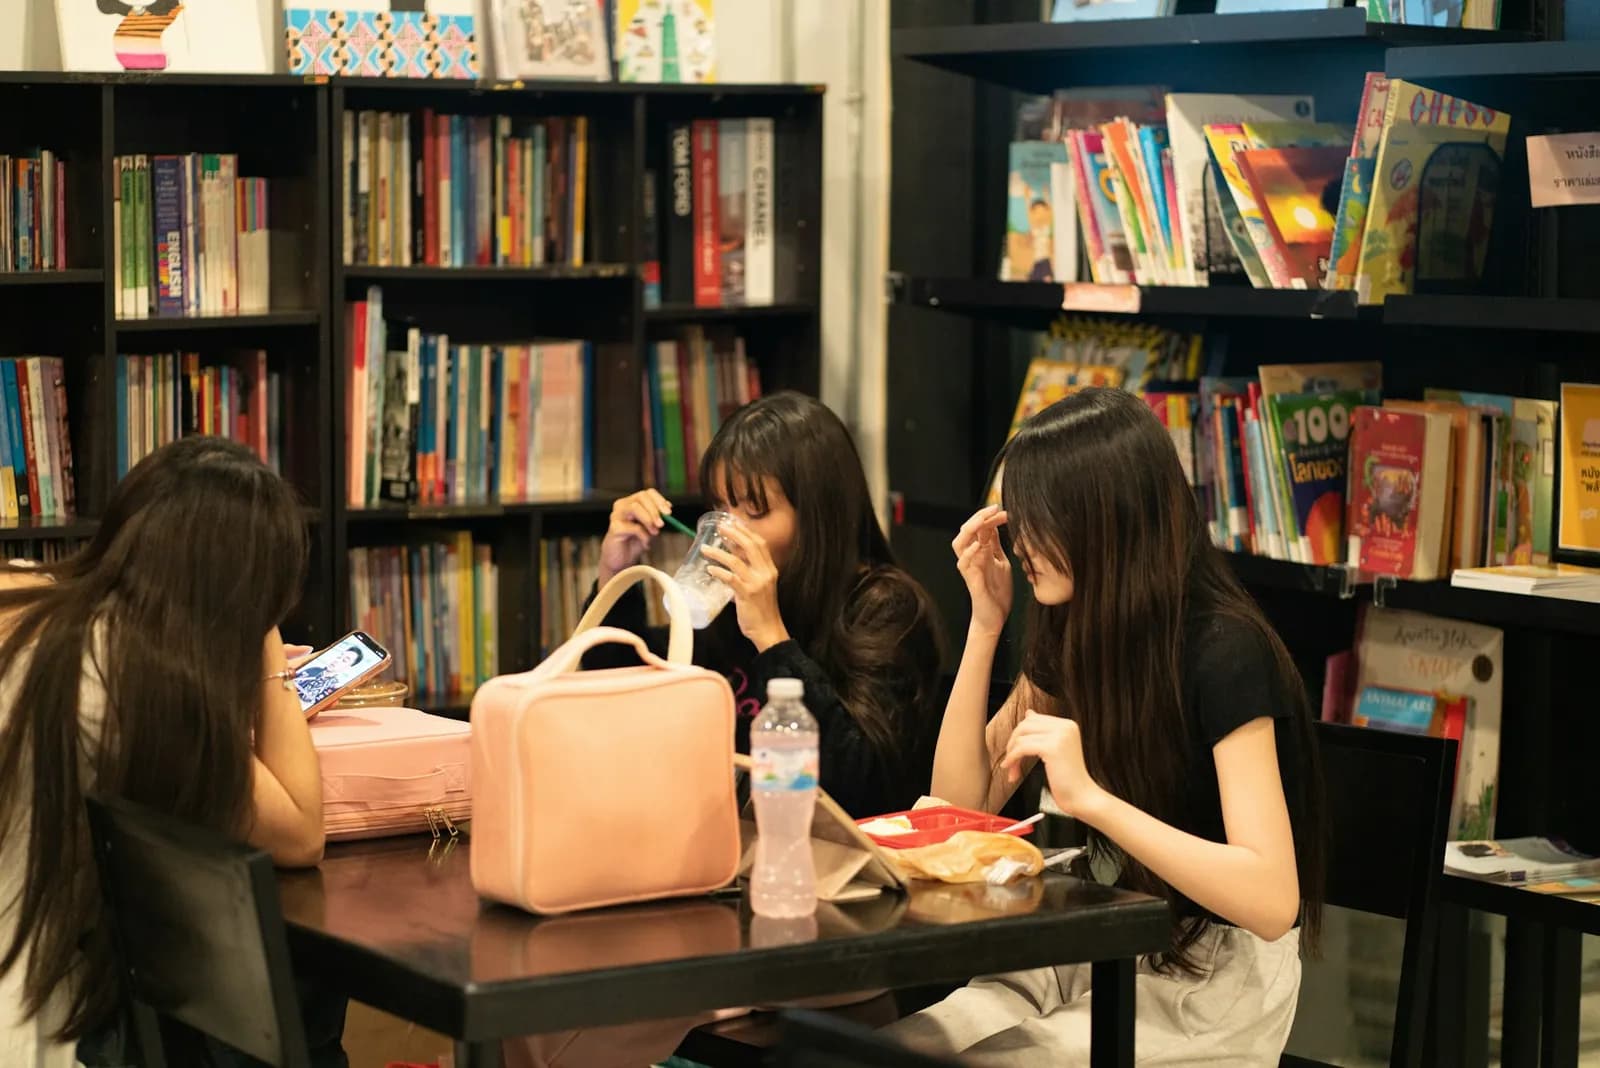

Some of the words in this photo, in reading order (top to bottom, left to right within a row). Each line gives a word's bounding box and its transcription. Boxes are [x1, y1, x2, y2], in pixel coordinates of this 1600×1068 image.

[1410, 90, 1497, 127] CHESS
[673, 128, 690, 166] TOM
[674, 167, 691, 216] FORD
[752, 166, 768, 249] CHANEL
[167, 231, 182, 297] ENGLISH
[1293, 402, 1349, 445] 100
[1366, 691, 1408, 708] ANIMAL
